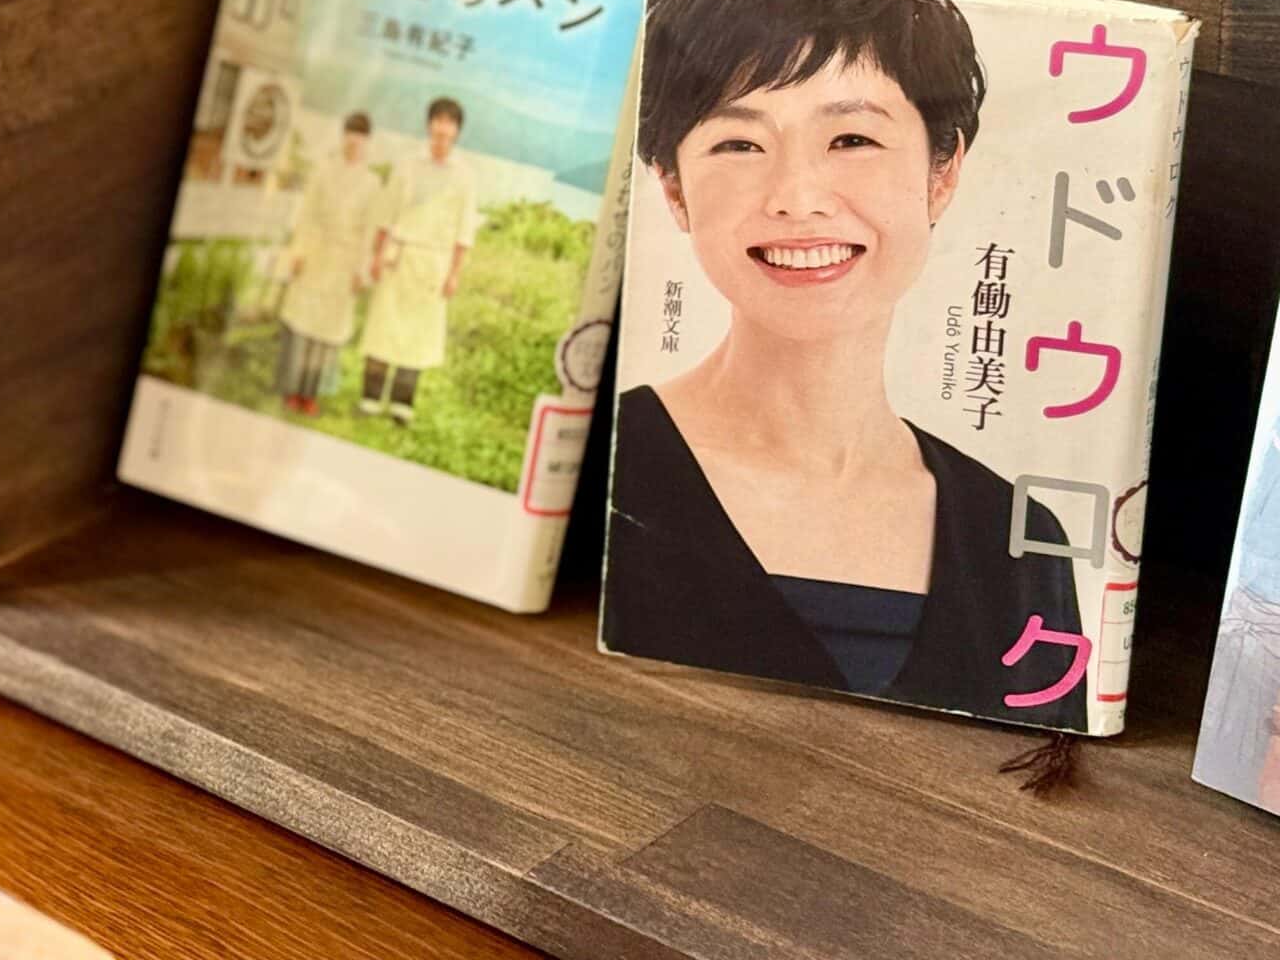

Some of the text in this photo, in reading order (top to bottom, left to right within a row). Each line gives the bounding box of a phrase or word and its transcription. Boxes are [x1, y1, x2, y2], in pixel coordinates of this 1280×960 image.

[660, 279, 685, 354] 新潮文庫
[940, 343, 961, 401] Yumiko
[962, 242, 1016, 431] 有働由美子
[1001, 23, 1147, 708] ウドウロク
